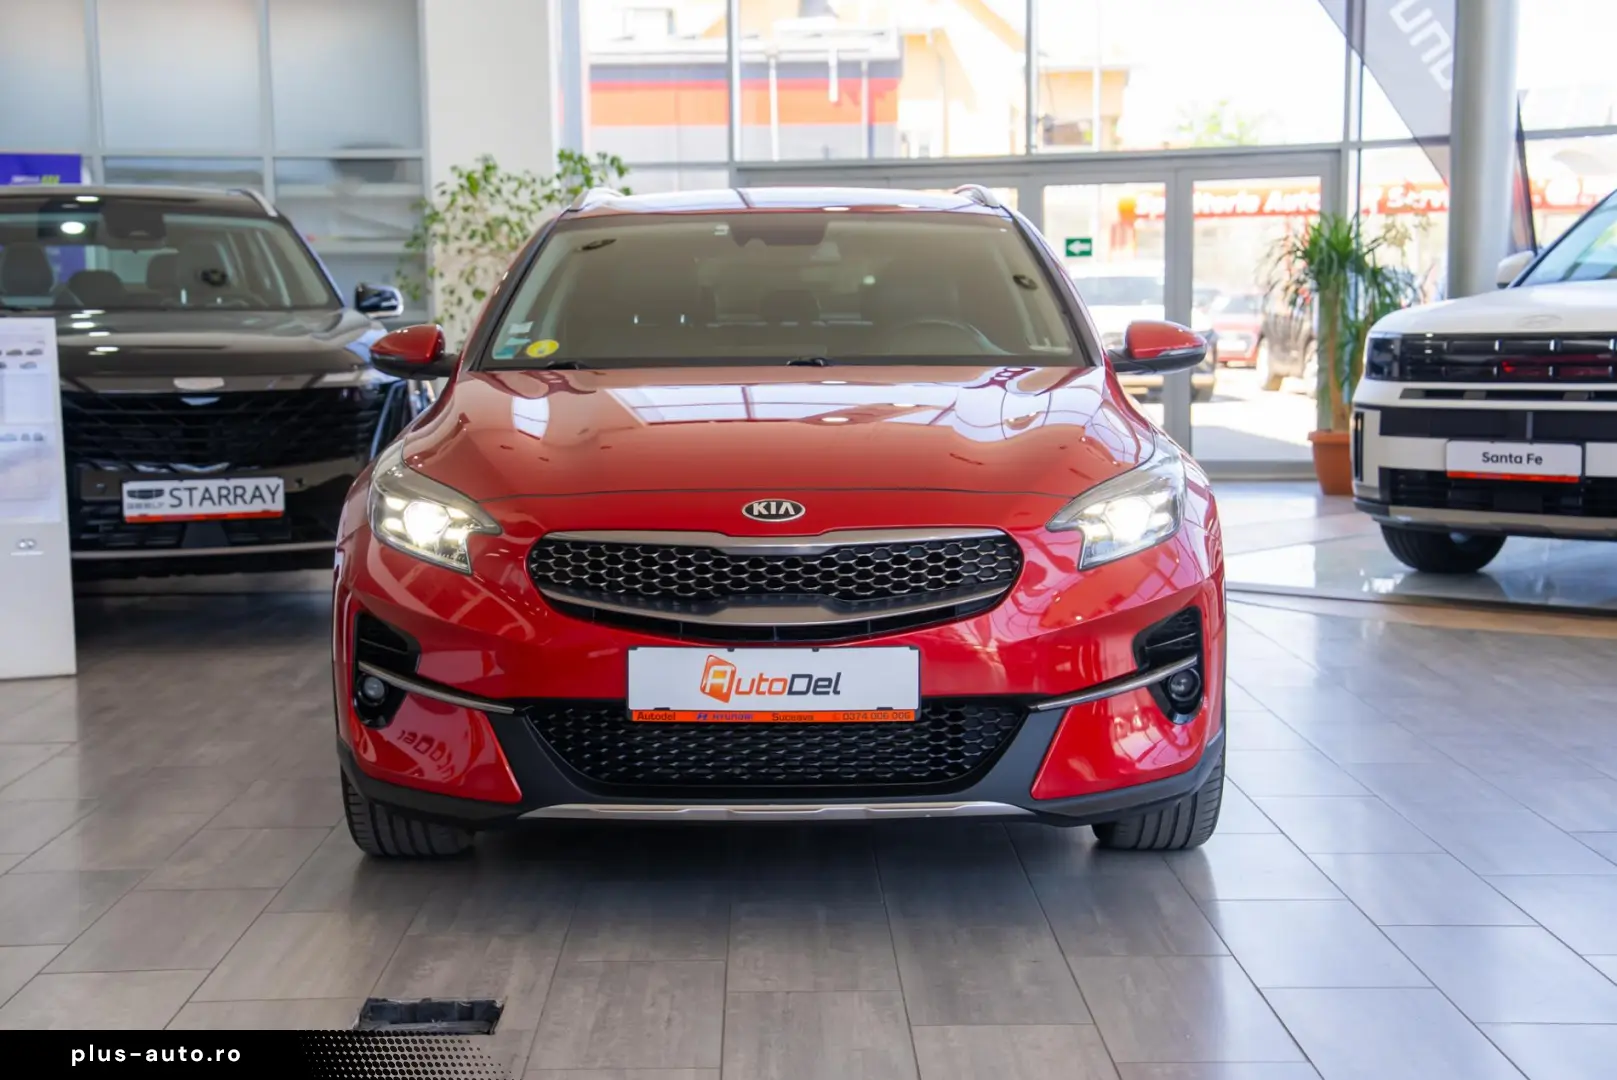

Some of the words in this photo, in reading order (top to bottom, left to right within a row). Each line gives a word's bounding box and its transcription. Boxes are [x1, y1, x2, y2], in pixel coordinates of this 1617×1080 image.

[1481, 451, 1523, 465] Santa
[1526, 453, 1544, 466] Fe
[169, 483, 281, 509] STARRAY
[752, 501, 796, 516] KIA
[703, 662, 842, 696] AutoDel
[636, 711, 676, 721] Autodel
[842, 710, 869, 721] 0374
